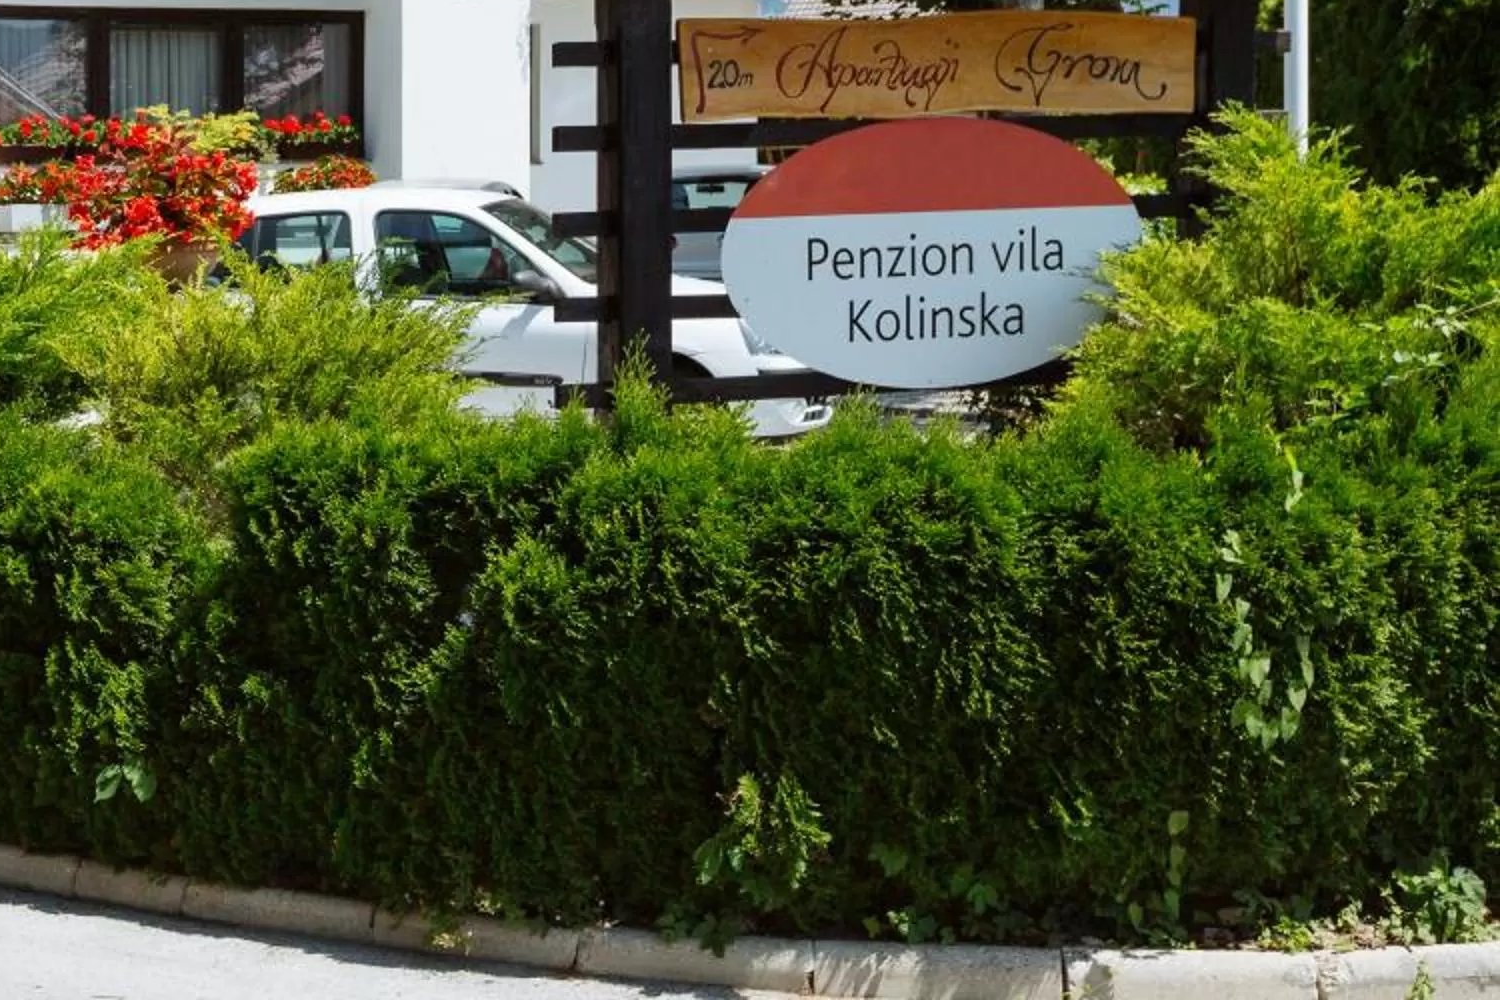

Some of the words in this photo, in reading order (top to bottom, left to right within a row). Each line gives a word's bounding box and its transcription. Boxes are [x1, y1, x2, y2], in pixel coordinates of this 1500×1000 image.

[995, 22, 1167, 107] Grom
[807, 232, 974, 281] Penzion
[991, 225, 1064, 272] vila
[848, 291, 1025, 343] Kolinska
